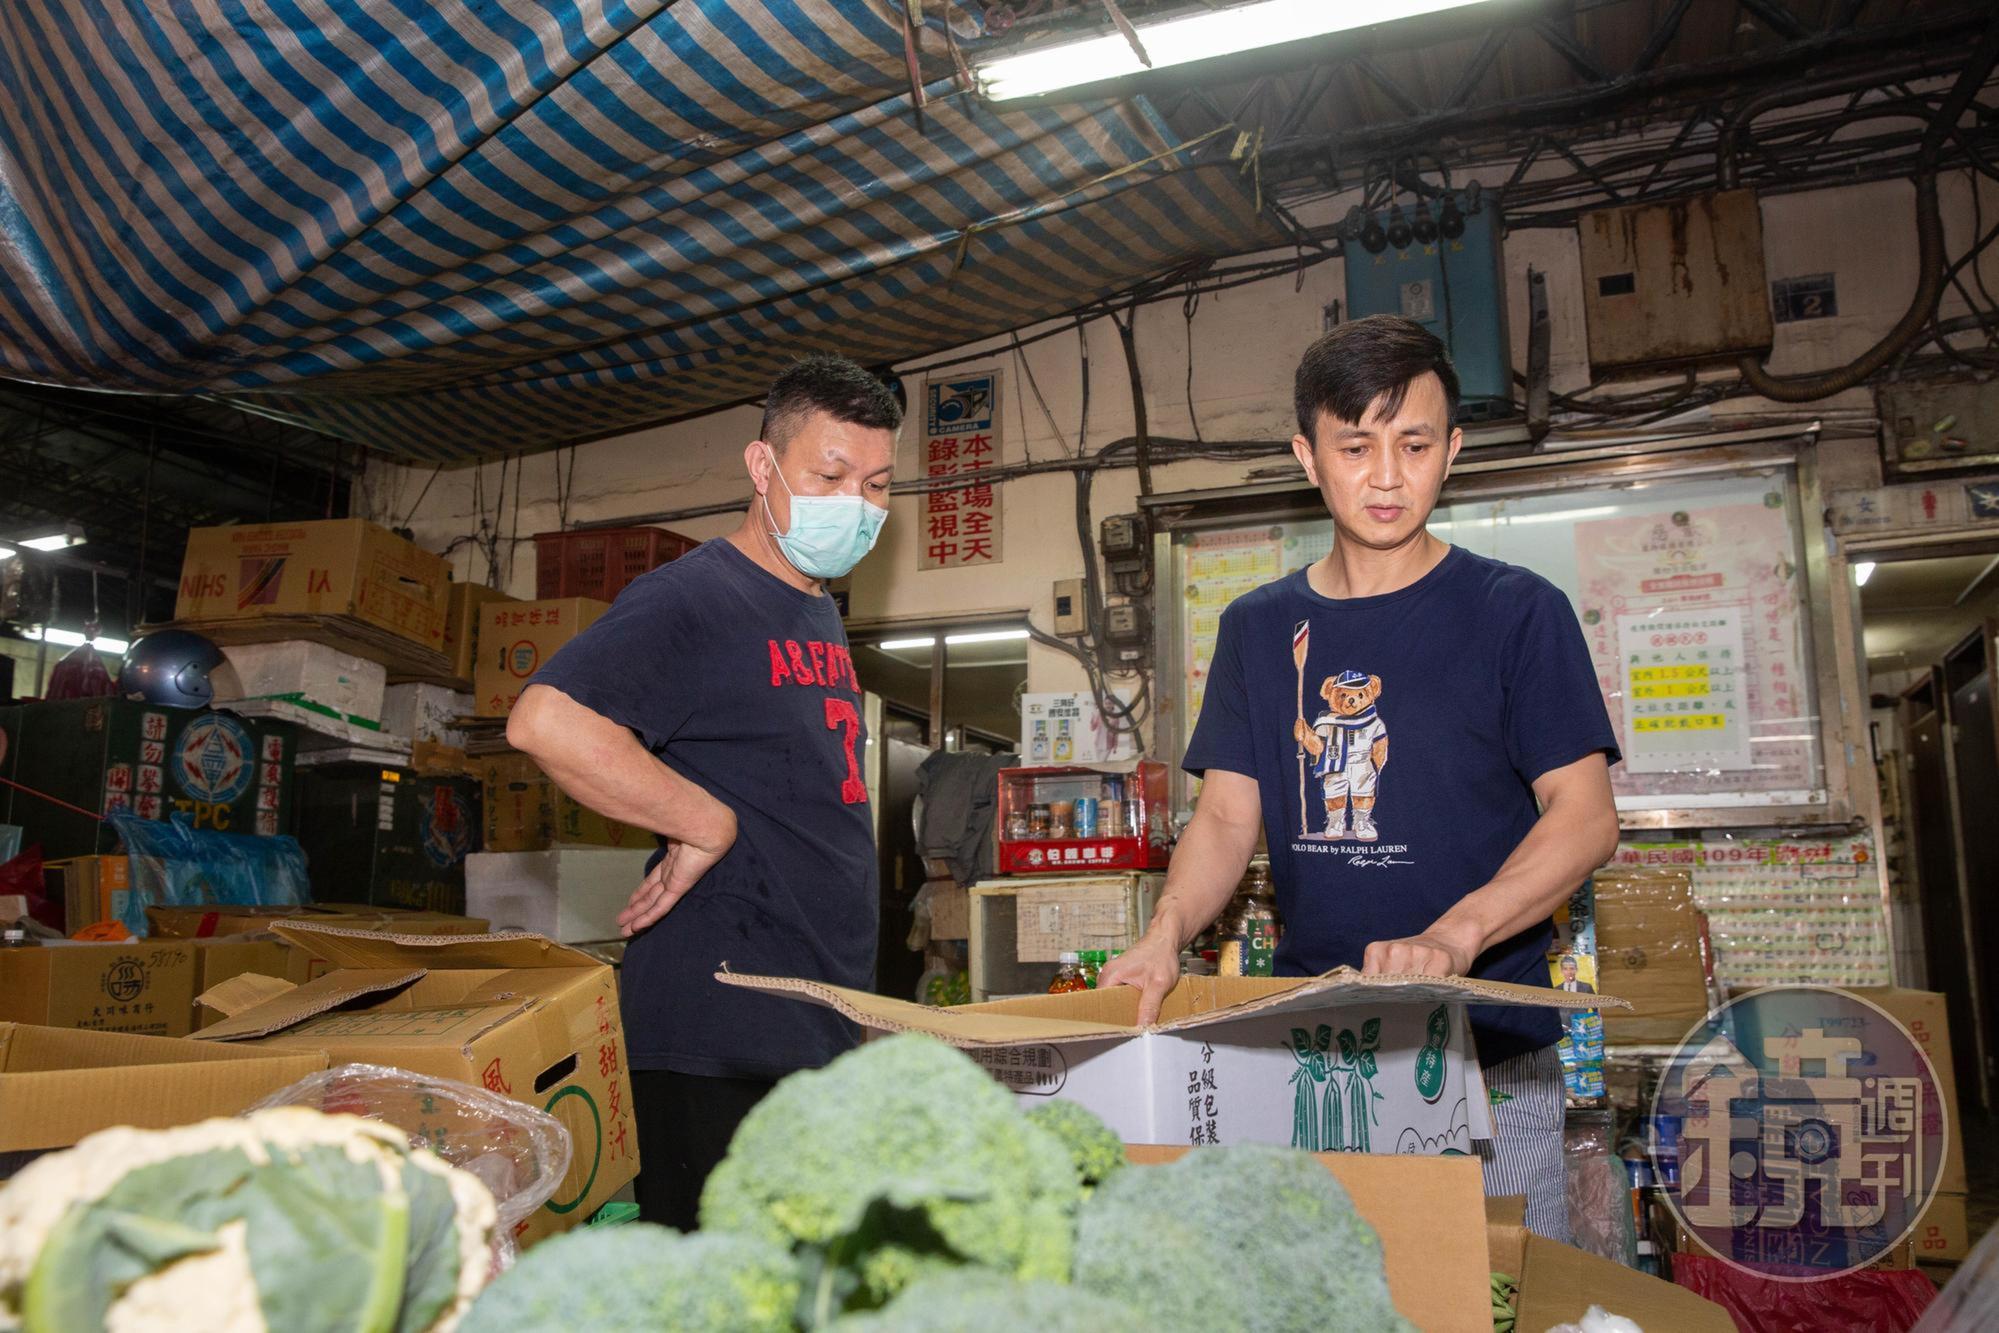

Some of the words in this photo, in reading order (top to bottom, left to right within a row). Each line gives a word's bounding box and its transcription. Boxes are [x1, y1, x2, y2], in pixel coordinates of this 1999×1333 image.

[938, 423, 979, 434] CAMERA
[927, 438, 959, 564] 錄影監視中
[962, 434, 993, 562] 本市場全天
[824, 697, 867, 805] 7
[1307, 844, 1329, 854] BEAR
[1330, 845, 1339, 855] by
[1340, 845, 1368, 855] RALPH
[1371, 845, 1408, 854] LAUREN
[1609, 847, 1769, 866] 華民國109年
[1201, 1040, 1220, 1145] 分級包裝
